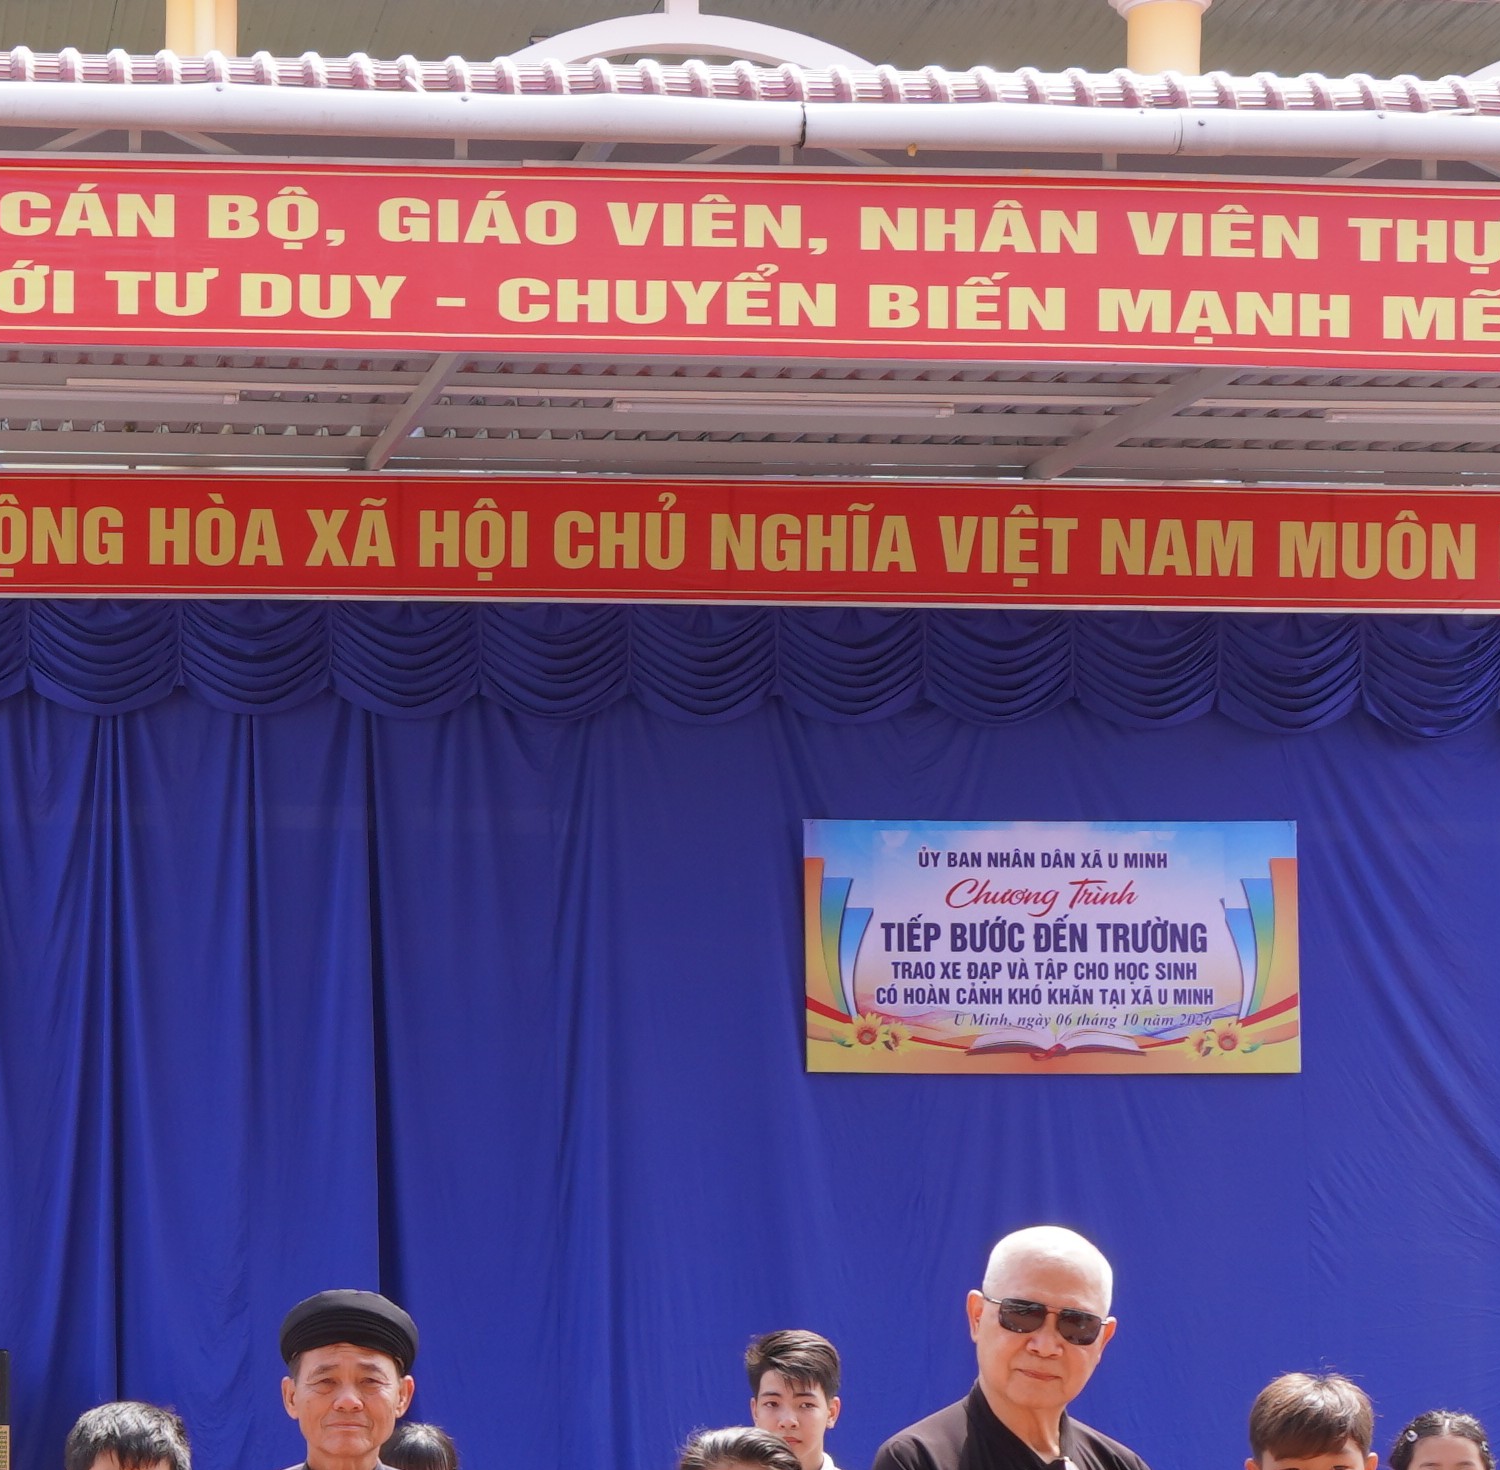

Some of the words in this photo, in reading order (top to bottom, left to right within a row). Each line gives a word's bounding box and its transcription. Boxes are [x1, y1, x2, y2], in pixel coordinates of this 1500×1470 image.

[0, 184, 174, 238] CÁN
[208, 187, 345, 249] BỘ,
[379, 191, 576, 245] GIÁO
[607, 194, 827, 254] VIÊN,
[861, 200, 1097, 254] NHÂN
[1127, 205, 1318, 259] VIÊN
[105, 268, 219, 316] TƯ
[241, 273, 406, 319] DUY
[499, 265, 836, 328] CHUYỂN
[869, 272, 1065, 330] BIẾN
[1099, 289, 1350, 345] MẠNH
[150, 495, 283, 566] HÒA
[306, 498, 395, 567] XÃ
[420, 499, 527, 581] HỘI
[554, 499, 685, 570] CHỦ
[711, 503, 916, 572] NGHĨA
[939, 505, 1077, 587] VIỆT
[1101, 518, 1253, 577] NAM
[1280, 510, 1475, 580] MUÔN
[918, 846, 942, 868] ỦY
[948, 852, 981, 868] BAN
[988, 848, 1034, 868] NHÂN
[1041, 848, 1074, 868] DÂN
[1081, 849, 1102, 868] XÃ
[1109, 853, 1118, 868] U
[1124, 852, 1168, 869] MINH
[945, 878, 1060, 917] Chương
[1068, 878, 1139, 909] Trình
[881, 913, 941, 953] TIẾP
[950, 916, 1024, 953] BƯỚC
[1033, 913, 1089, 953] ĐẾN
[1097, 916, 1208, 954] TRƯỜNG
[892, 961, 936, 980] TRAO
[941, 961, 962, 980] XE
[967, 962, 1002, 984] ĐẠP
[1008, 958, 1030, 980] VÀ
[1035, 957, 1068, 984] TẬP
[1074, 962, 1109, 981] CHO
[1115, 963, 1149, 985] HỌC
[1155, 963, 1197, 981] SINH
[876, 983, 898, 1005] CÓ
[904, 984, 950, 1005] HOÀN
[956, 983, 1002, 1006] CẢNH
[1008, 984, 1042, 1006] KHÓ
[1048, 985, 1094, 1006] KHĂN
[1100, 989, 1126, 1010] TẠI
[1131, 985, 1153, 1006] XÃ
[1159, 989, 1168, 1005] U
[1174, 989, 1214, 1006] MINH
[969, 1013, 1012, 1028] Minh,
[1017, 1013, 1051, 1029] ngày
[1055, 1013, 1072, 1026] 06
[1077, 1013, 1117, 1029] tháng
[1122, 1013, 1139, 1026] 10
[1143, 1013, 1174, 1026] năm
